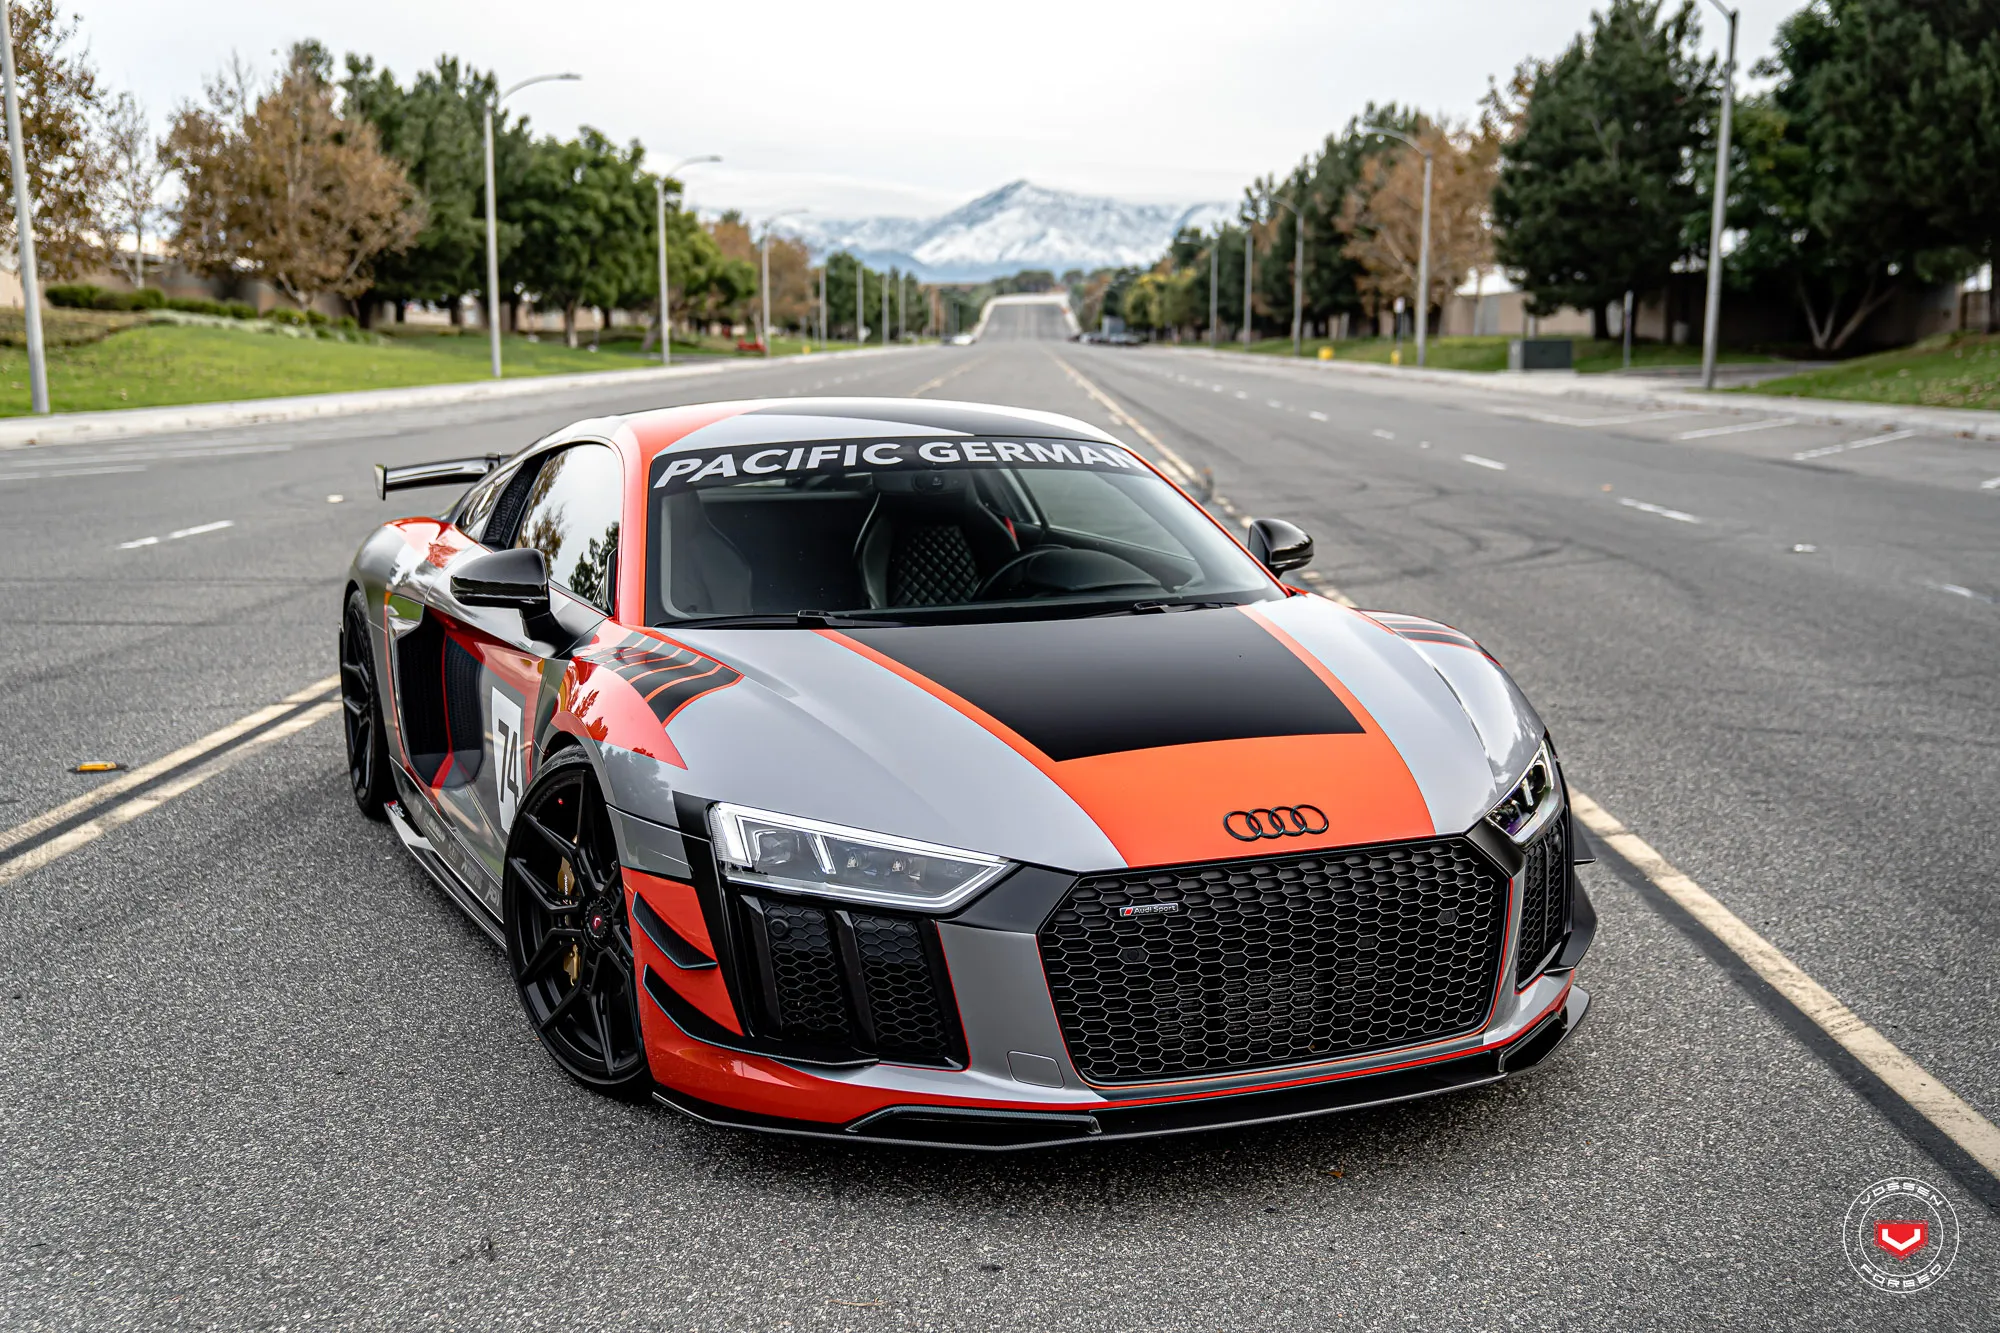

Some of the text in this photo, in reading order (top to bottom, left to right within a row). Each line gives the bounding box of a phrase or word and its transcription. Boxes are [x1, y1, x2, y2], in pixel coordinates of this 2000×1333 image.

[653, 440, 1151, 489] PACIFIC GERMAN
[498, 718, 519, 811] 74
[1134, 905, 1176, 914] Audi Sport
